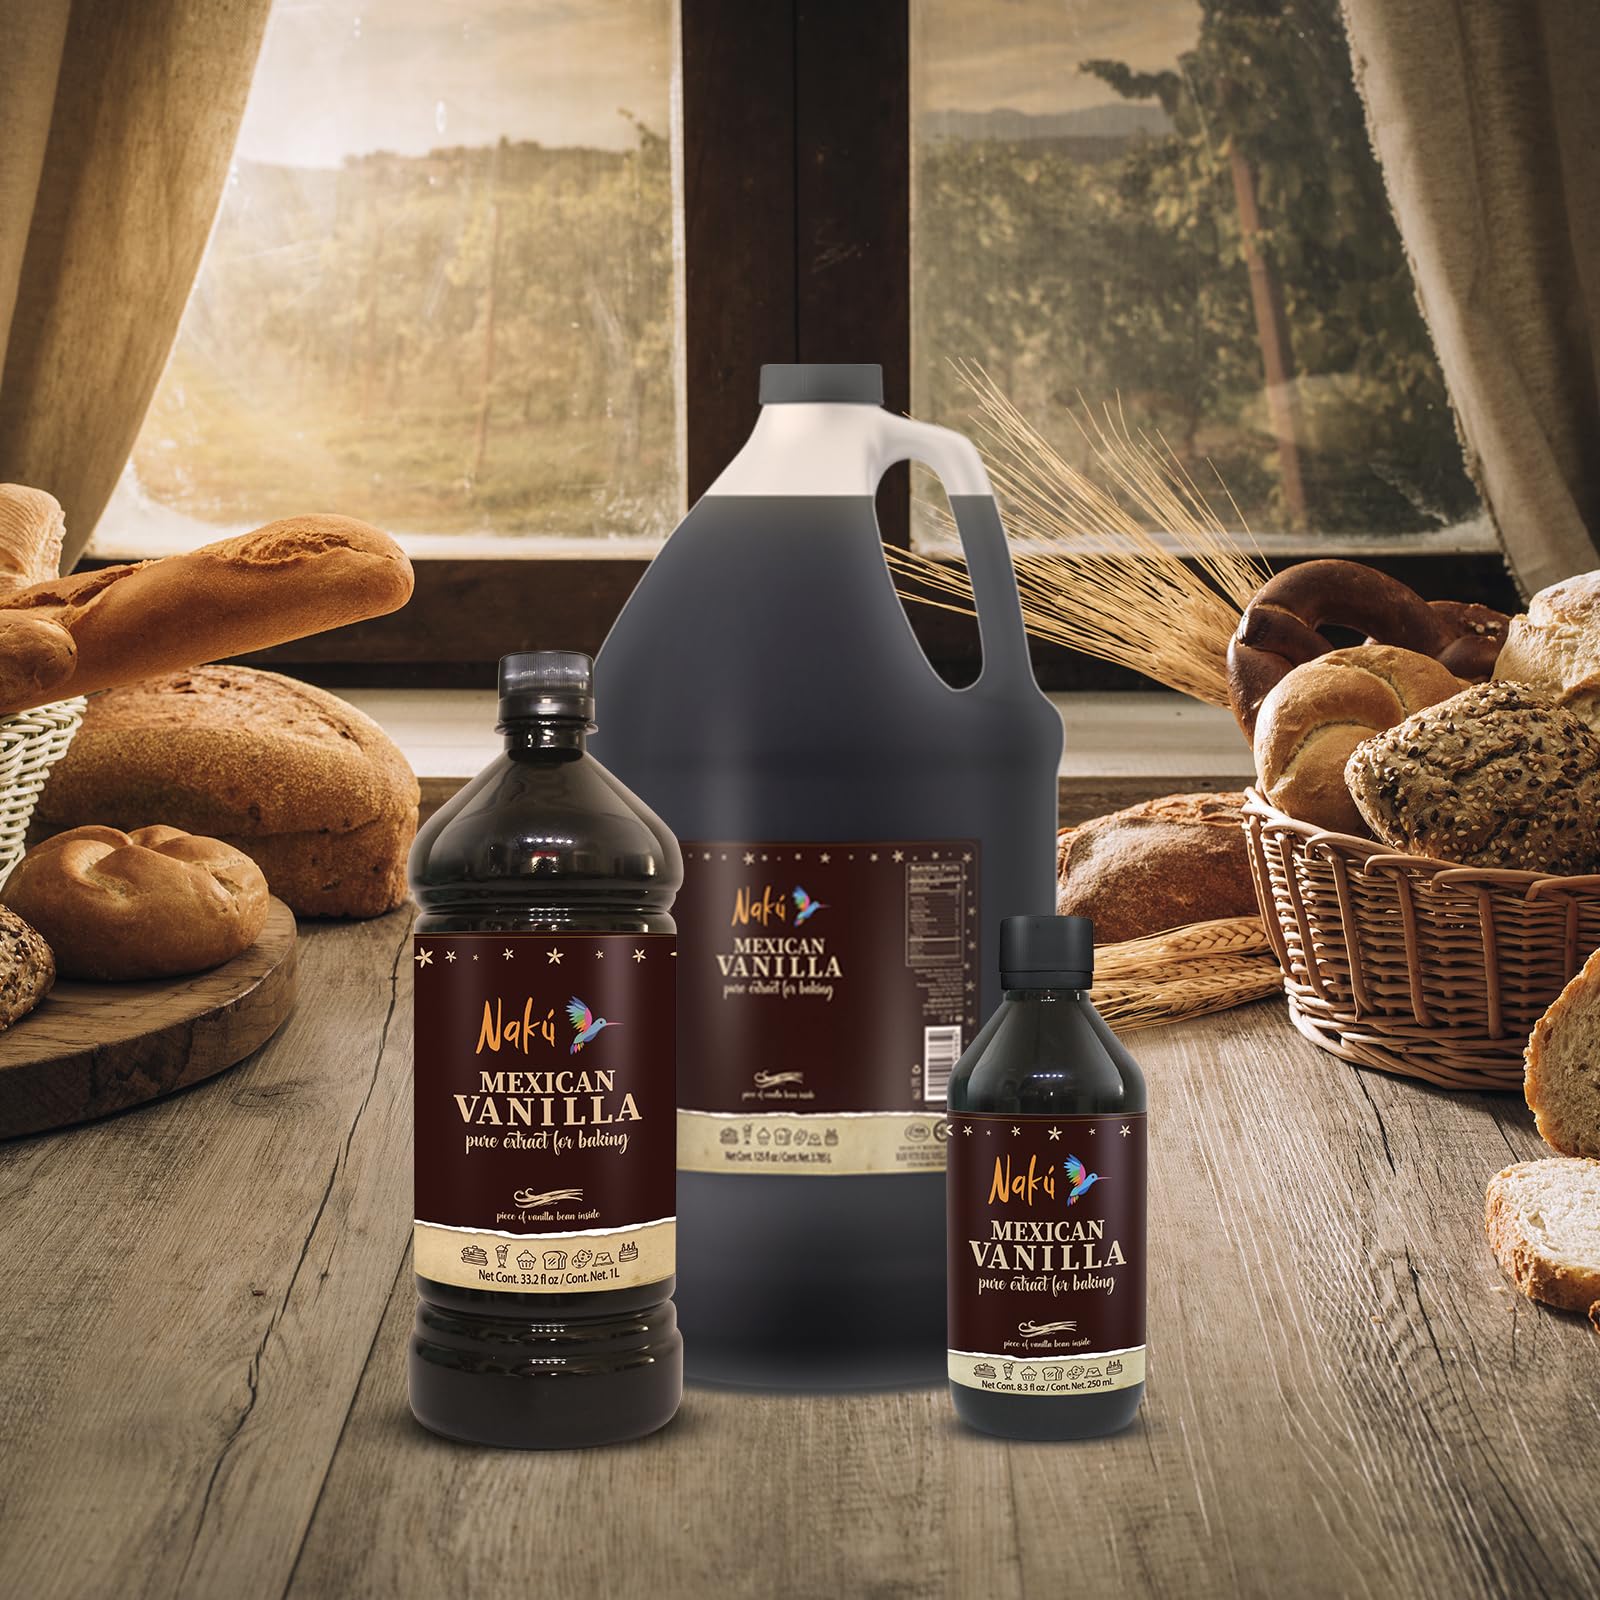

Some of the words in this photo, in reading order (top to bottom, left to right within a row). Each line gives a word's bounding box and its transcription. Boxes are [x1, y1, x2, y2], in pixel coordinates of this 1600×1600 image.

[731, 886, 786, 926] Nakú
[734, 937, 825, 955] MEXICAN
[716, 954, 843, 978] VANILLA
[723, 984, 746, 1000] pure
[782, 980, 796, 999] for
[798, 980, 833, 1002] baking
[476, 997, 556, 1055] Nakú
[479, 1070, 616, 1094] MEXICAN
[453, 1093, 643, 1126] VANILLA
[465, 1133, 499, 1155] pure
[503, 1131, 550, 1150] extract
[551, 1130, 575, 1156] for
[578, 1129, 631, 1155] baking
[988, 1154, 1055, 1206] Nakú
[496, 1211, 515, 1223] piece
[518, 1210, 526, 1224] of
[528, 1211, 554, 1221] vanilla
[556, 1211, 575, 1221] bean
[577, 1209, 600, 1220] inside
[991, 1219, 1105, 1242] MEXICAN
[968, 1240, 1127, 1271] VANILLA
[478, 1269, 494, 1281] Net
[495, 1271, 519, 1284] Cont.
[520, 1273, 539, 1284] 33.2
[540, 1273, 547, 1285] fl
[548, 1275, 559, 1285] oz
[565, 1273, 589, 1284] Cont.
[590, 1270, 608, 1282] Net.
[609, 1267, 620, 1279] 1L
[978, 1275, 1006, 1295] pure
[1009, 1275, 1050, 1292] extract
[1052, 1274, 1070, 1297] for
[1073, 1274, 1116, 1296] baking
[1021, 1339, 1029, 1350] of
[981, 1380, 994, 1389] Net
[996, 1381, 1016, 1391] Cont.
[1017, 1383, 1029, 1391] 8.3
[1029, 1383, 1036, 1391] fl
[1050, 1382, 1070, 1391] Cont.
[1071, 1381, 1086, 1391] Net.
[1087, 1379, 1101, 1389] 250
